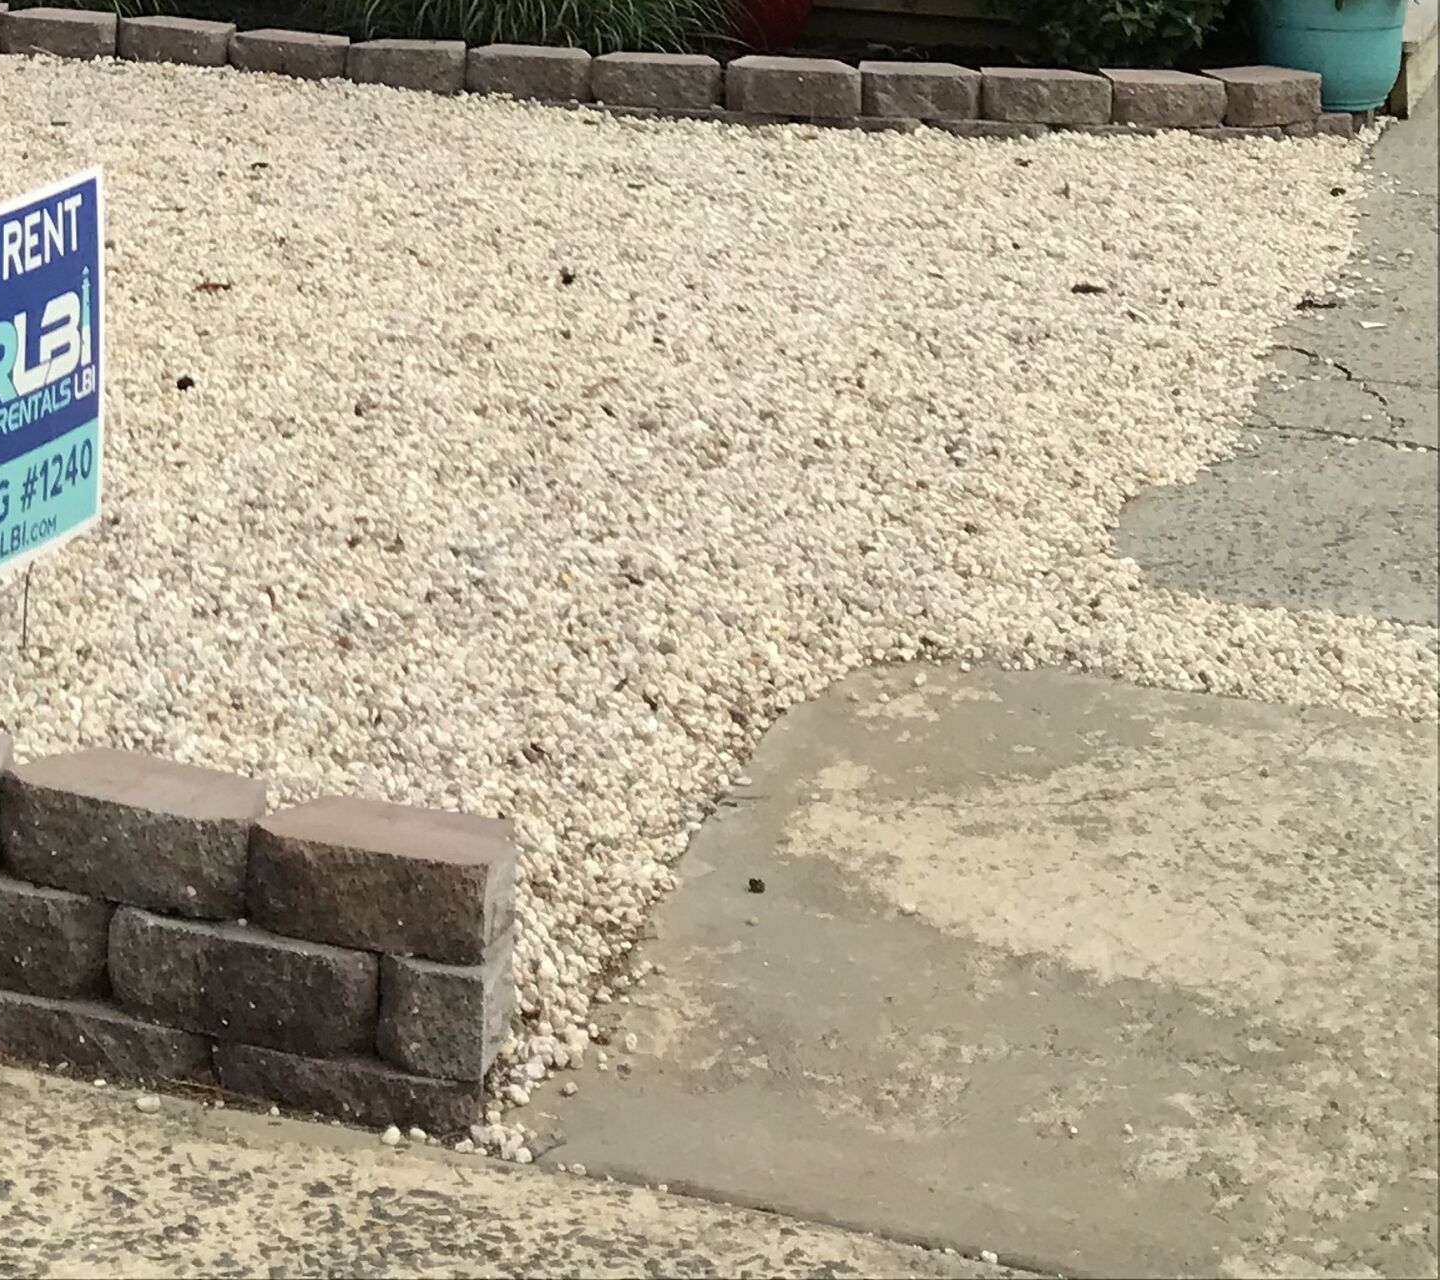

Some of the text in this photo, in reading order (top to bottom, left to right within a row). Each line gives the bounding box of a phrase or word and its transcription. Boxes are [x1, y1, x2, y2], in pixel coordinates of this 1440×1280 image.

[2, 193, 83, 281] RENT
[74, 364, 97, 401] LBI
[20, 438, 93, 513] #1240
